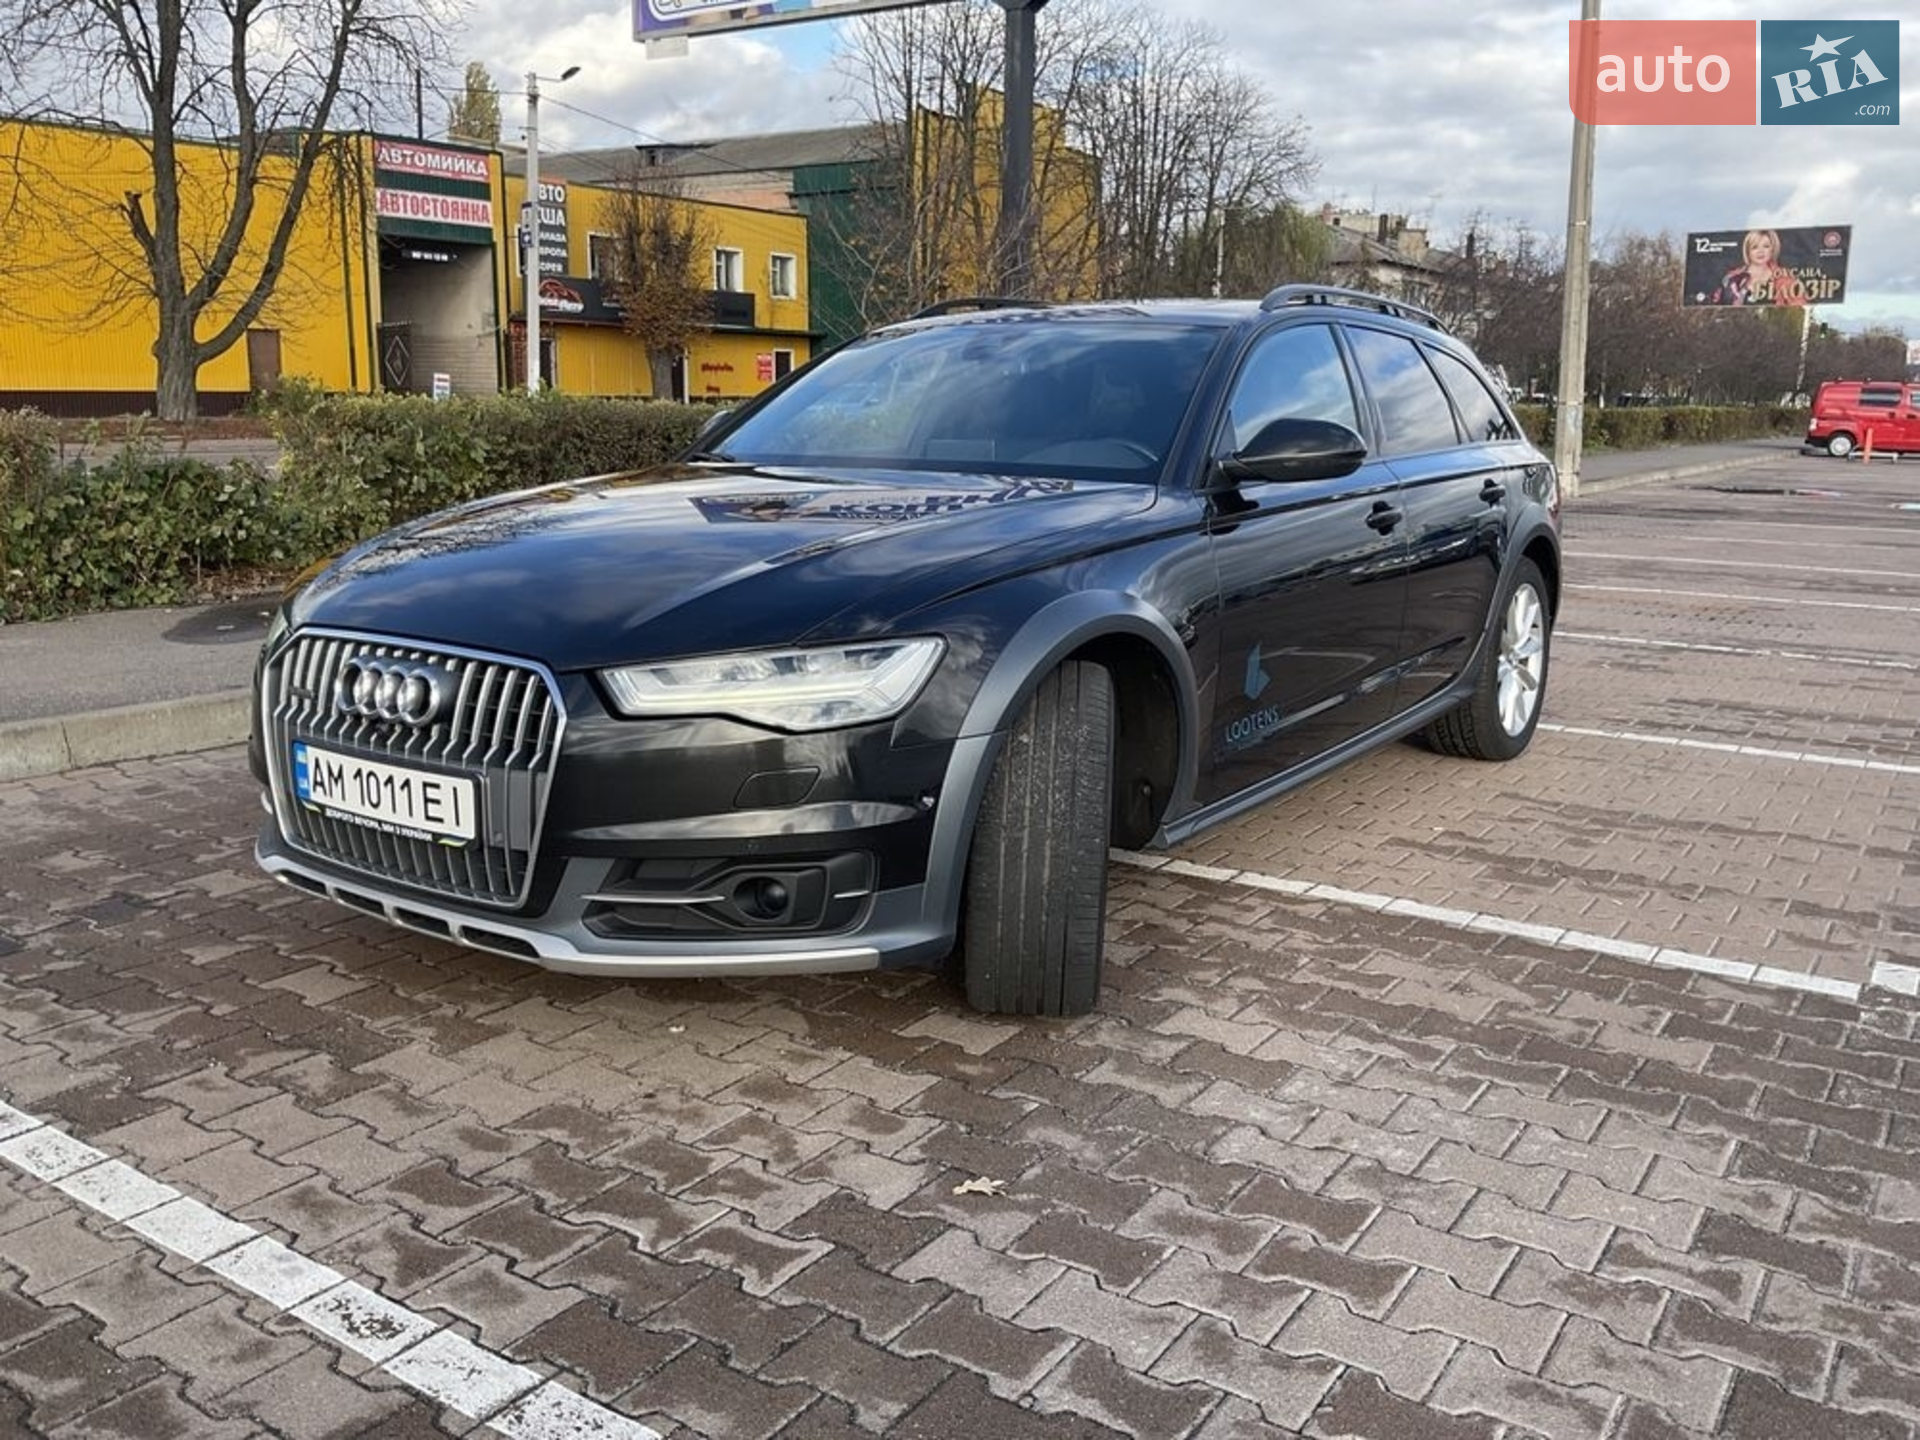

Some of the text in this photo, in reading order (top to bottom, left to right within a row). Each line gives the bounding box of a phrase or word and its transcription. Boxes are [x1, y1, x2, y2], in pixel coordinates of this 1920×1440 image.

[378, 147, 488, 176] АВТОМИЙКА
[379, 189, 490, 223] АВТОСТОЯНКА
[539, 184, 565, 202] ВТО
[1226, 705, 1279, 742] LOOTENS
[312, 756, 346, 802] AM
[353, 767, 413, 818] 1011
